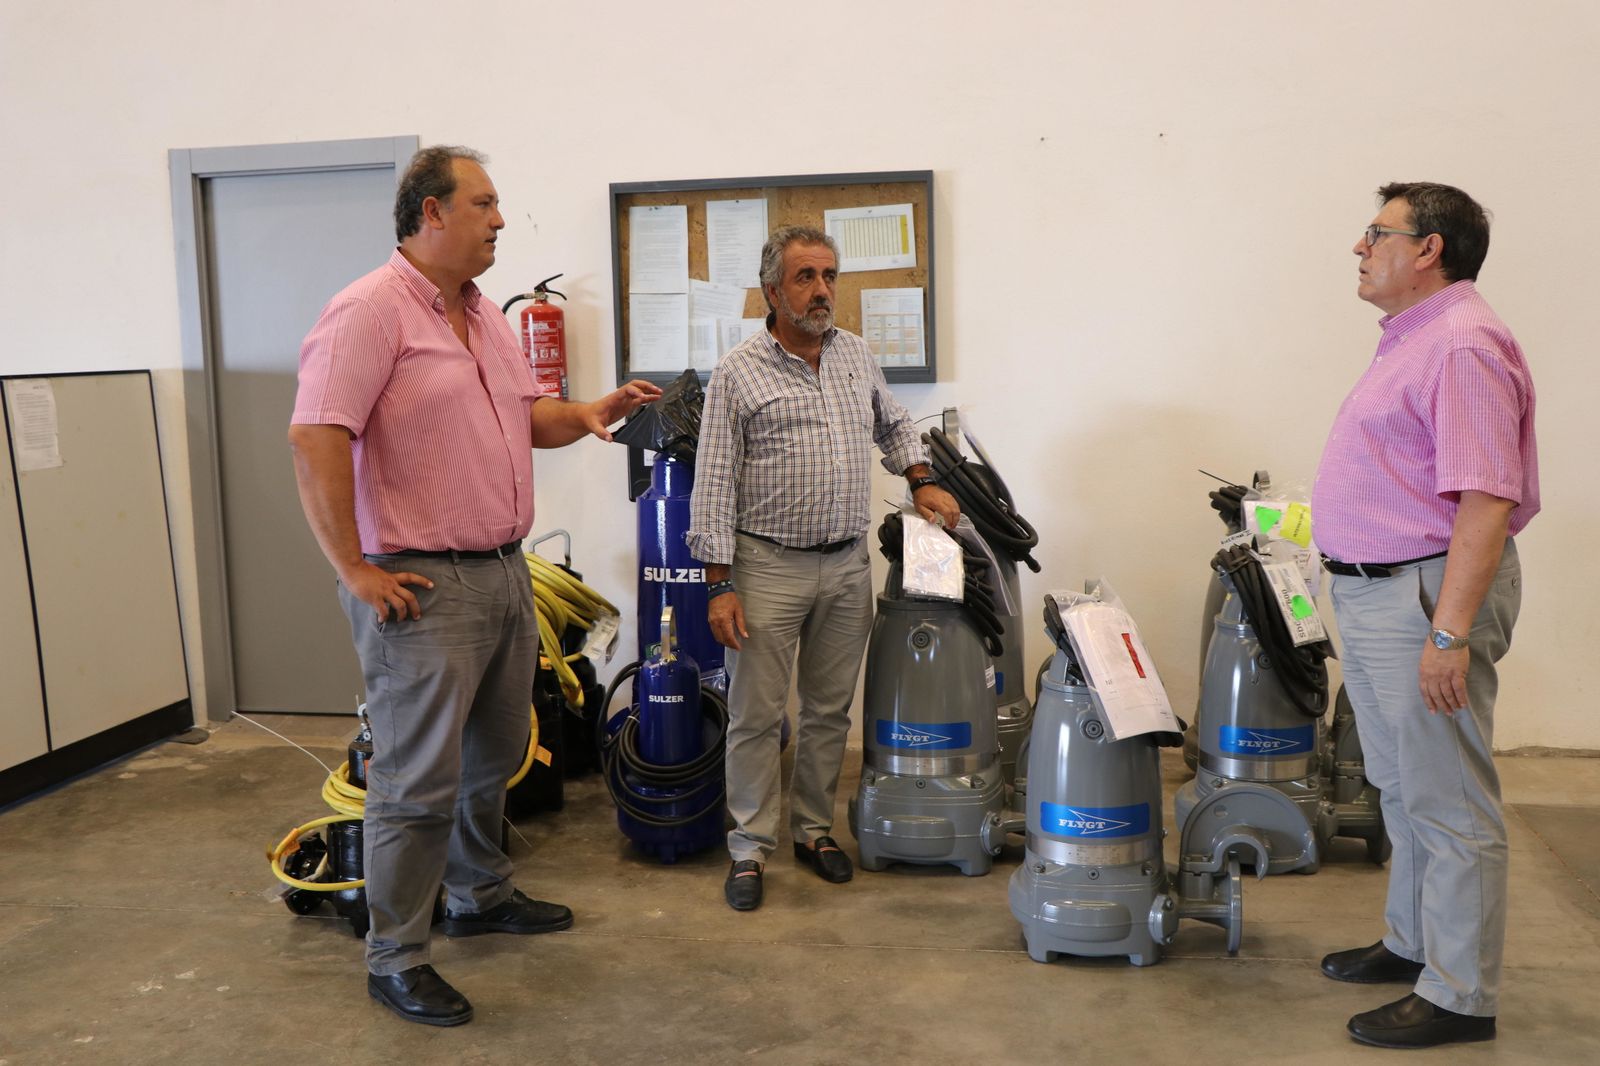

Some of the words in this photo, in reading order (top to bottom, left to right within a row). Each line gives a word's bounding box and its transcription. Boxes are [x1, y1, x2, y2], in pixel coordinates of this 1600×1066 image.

[648, 694, 684, 703] SULZER
[891, 732, 930, 742] FLYGT
[1238, 739, 1280, 748] FLYGT
[1058, 818, 1106, 829] FLYGT
